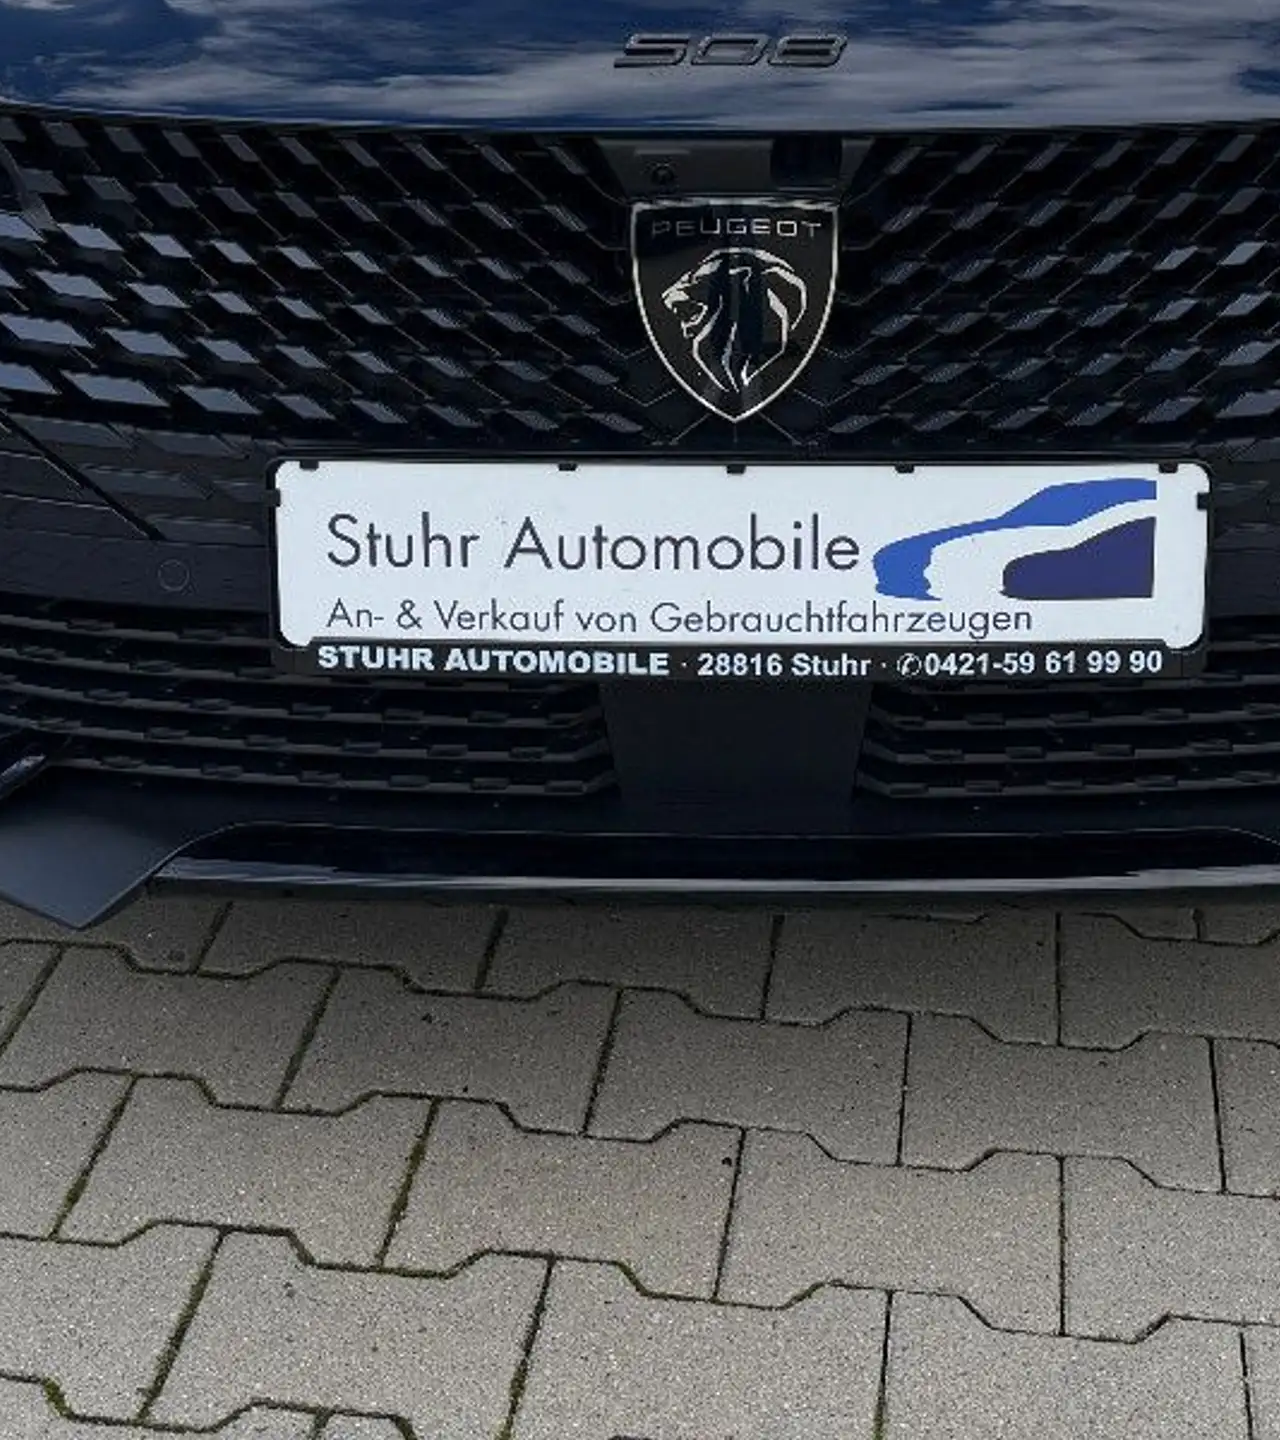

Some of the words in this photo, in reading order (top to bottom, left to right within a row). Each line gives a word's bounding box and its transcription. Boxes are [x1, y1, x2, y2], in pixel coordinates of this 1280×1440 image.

[613, 33, 848, 68] 508
[651, 217, 822, 240] PEUGEOT
[327, 511, 480, 568] Stuhr
[503, 513, 860, 571] Automobile
[326, 597, 385, 629] An-
[396, 599, 423, 630] &
[433, 598, 565, 632] Verkauf
[575, 610, 637, 633] von
[650, 600, 1032, 640] Gebrauchtfahrzeugen
[318, 645, 435, 671] STUHR
[443, 647, 670, 676] AUTOMOBILE
[697, 652, 783, 676] 28816
[791, 652, 872, 676] Stuhr
[924, 650, 1035, 676] 0421-59
[1045, 650, 1075, 674] 61
[1086, 650, 1121, 674] 99
[1129, 650, 1163, 673] 90
